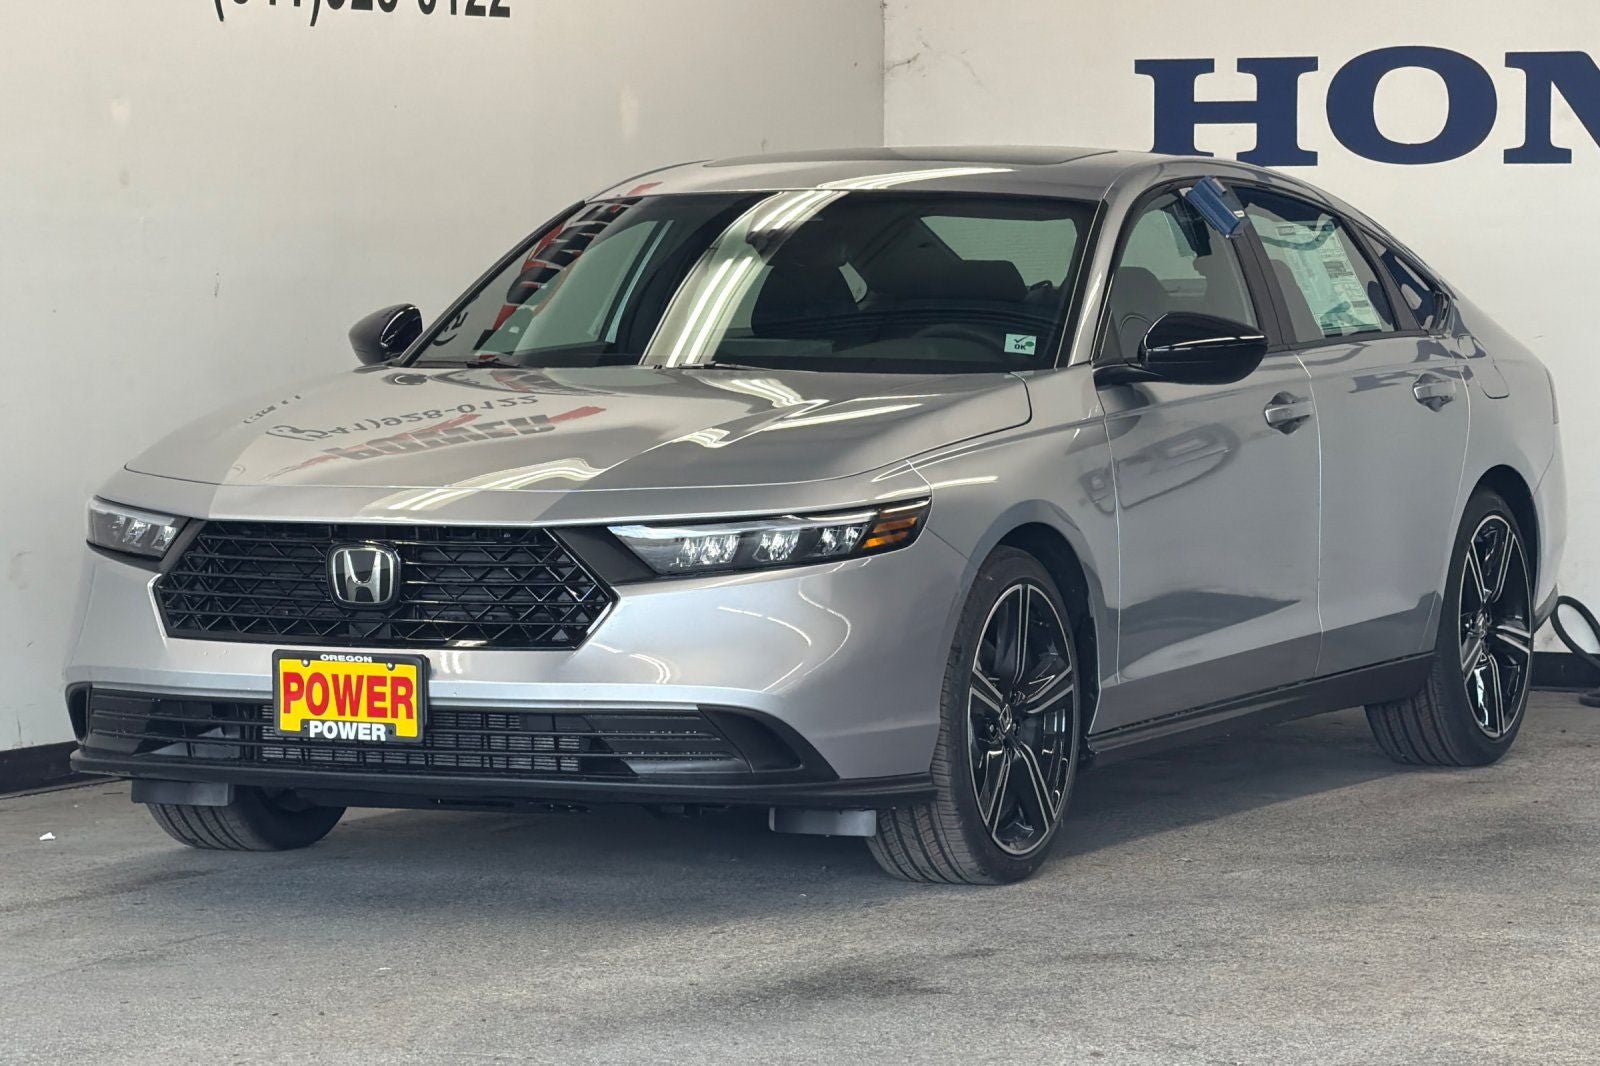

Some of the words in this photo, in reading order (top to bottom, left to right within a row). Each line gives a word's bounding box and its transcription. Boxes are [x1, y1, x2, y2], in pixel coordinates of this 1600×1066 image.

[319, 653, 373, 663] OREGON
[283, 671, 414, 720] POWER
[309, 720, 386, 741] POWER
